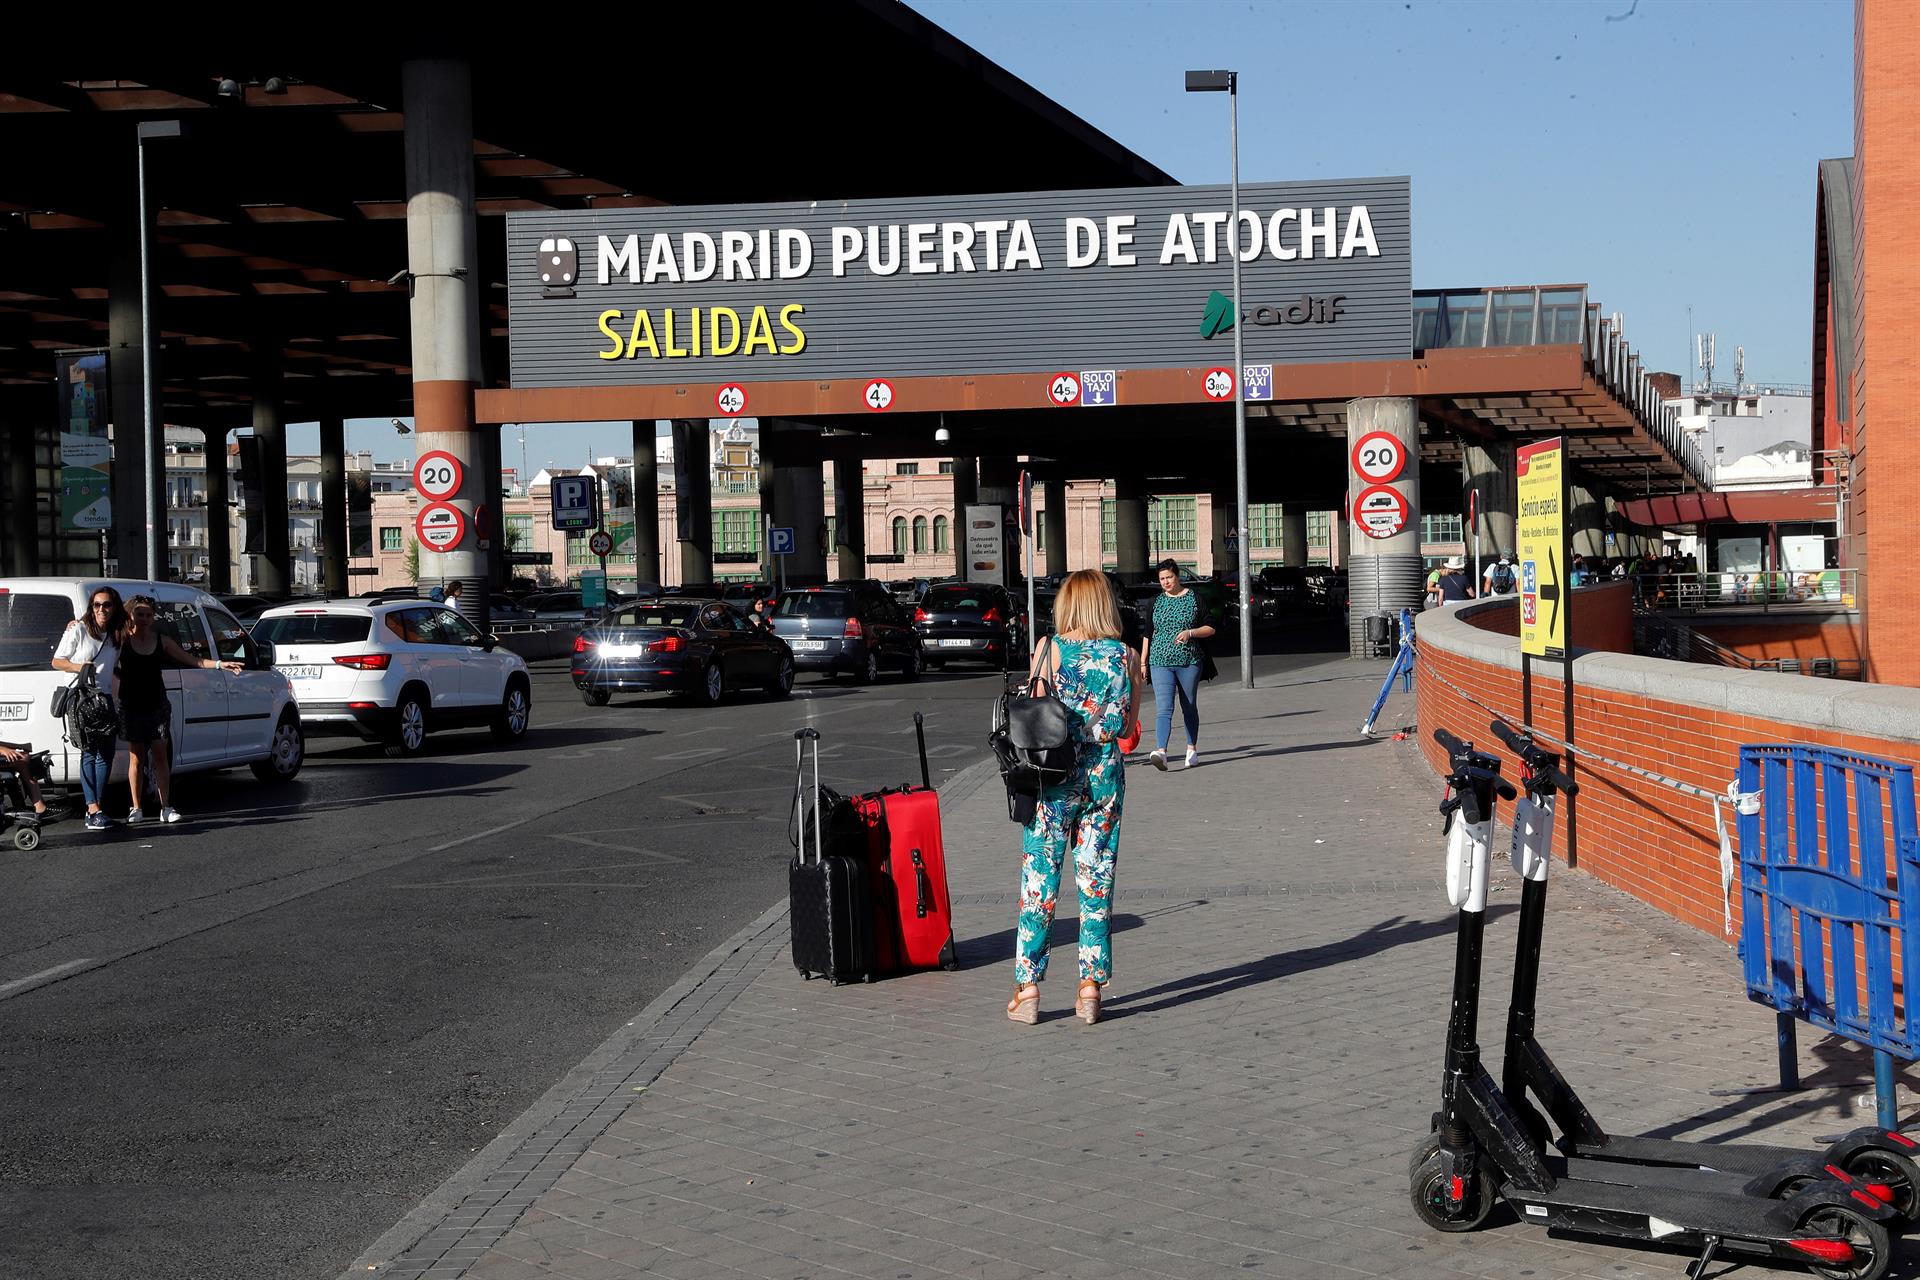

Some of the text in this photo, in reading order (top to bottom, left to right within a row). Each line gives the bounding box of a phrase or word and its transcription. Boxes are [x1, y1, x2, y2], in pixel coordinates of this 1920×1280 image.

[597, 205, 1381, 285] MADRID PUERTA DE ATOCHA
[1249, 294, 1347, 326] adif
[598, 304, 808, 361] SALIDAS
[1083, 373, 1113, 383] SOLO
[1086, 382, 1110, 392] TAXI
[1243, 377, 1267, 387] TAXI
[1363, 448, 1393, 467] 20
[424, 468, 451, 484] 20
[560, 482, 582, 508] P
[1521, 491, 1559, 520] Servicio especial
[773, 530, 789, 551] P
[279, 667, 318, 676] 622 KVL
[0, 705, 23, 718] HNP
